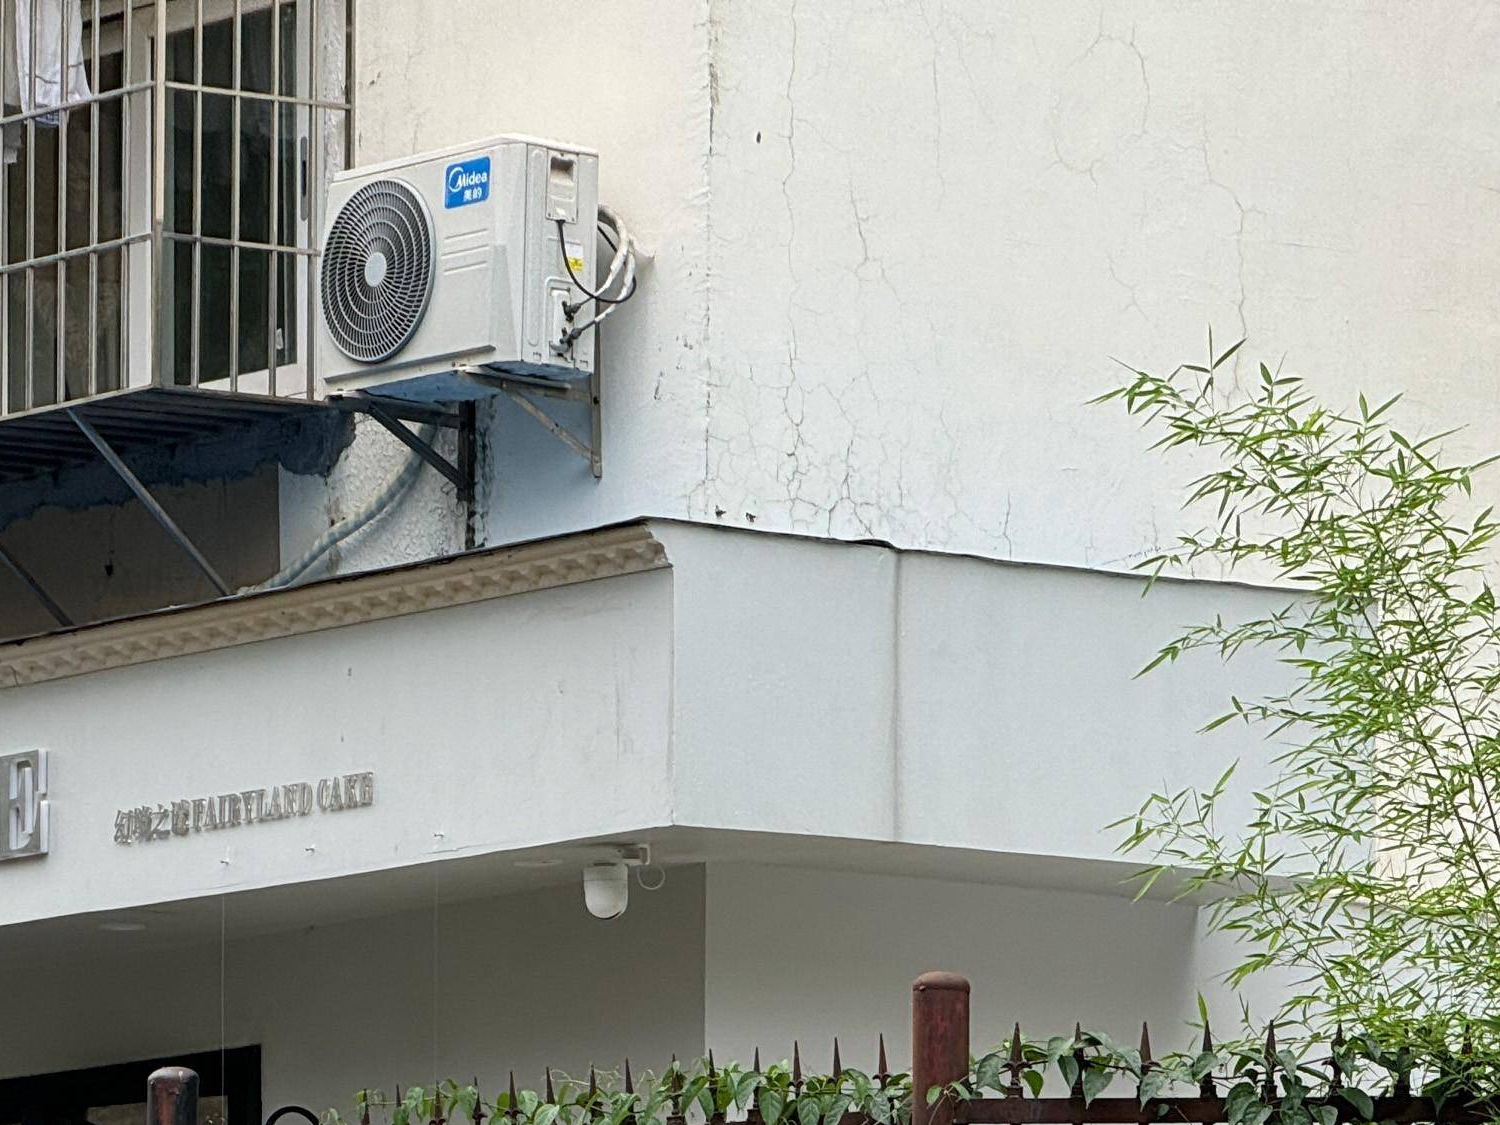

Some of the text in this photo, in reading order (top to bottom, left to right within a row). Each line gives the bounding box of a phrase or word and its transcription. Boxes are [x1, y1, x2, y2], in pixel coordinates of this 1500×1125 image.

[449, 167, 487, 192] Midea
[190, 782, 313, 832] FAIRYLAND
[316, 772, 373, 811] CAKE
